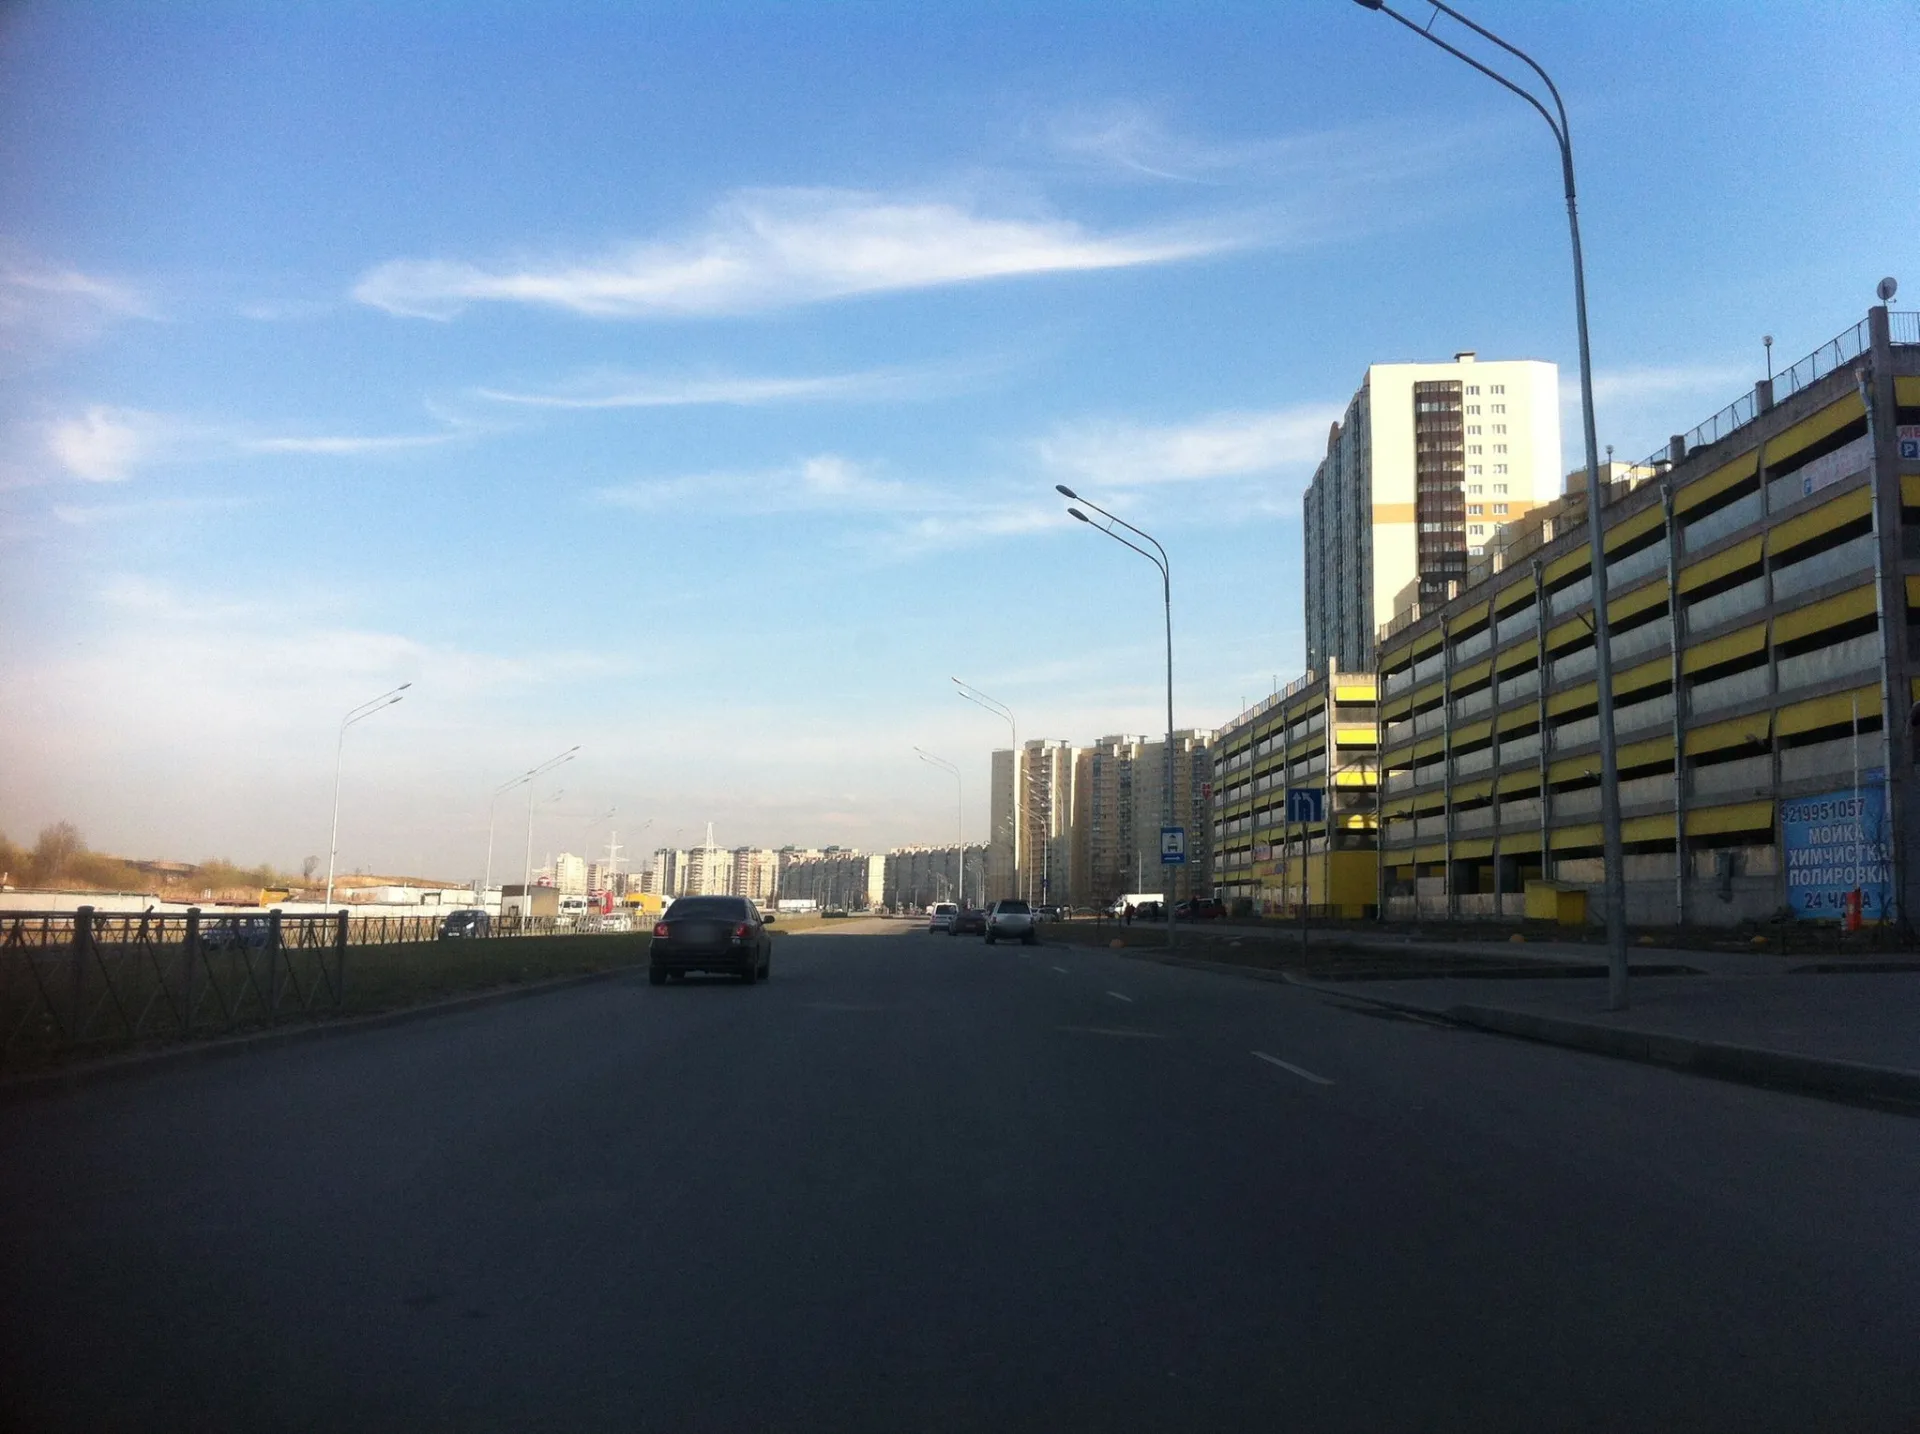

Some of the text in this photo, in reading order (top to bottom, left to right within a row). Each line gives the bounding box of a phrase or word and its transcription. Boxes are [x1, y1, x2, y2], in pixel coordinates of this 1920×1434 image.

[1781, 798, 1865, 823] 9219951057
[1808, 820, 1865, 845] МОЙКА
[1789, 865, 1890, 887] ПОЛИРОВКА
[1804, 889, 1872, 909] 24 ЧАА
